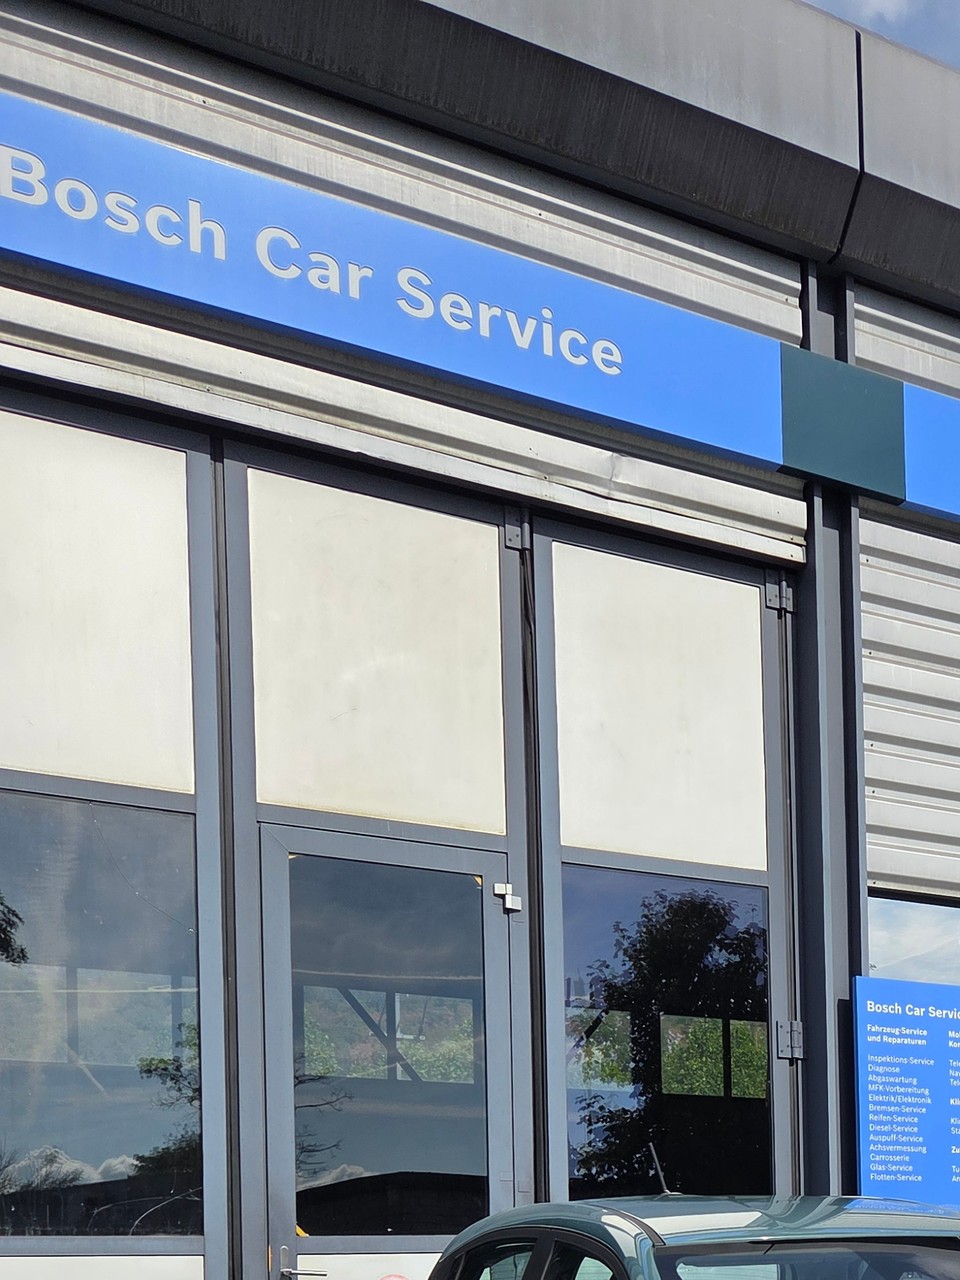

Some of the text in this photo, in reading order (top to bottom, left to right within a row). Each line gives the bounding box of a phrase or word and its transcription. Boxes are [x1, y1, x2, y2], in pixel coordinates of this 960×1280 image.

[0, 144, 624, 376] Bosch Car Service
[867, 1001, 902, 1015] Bosch
[905, 1004, 926, 1017] Car
[867, 1024, 928, 1036] Fahrzeug-Service
[882, 1035, 927, 1046] Reparaturen
[867, 1054, 935, 1066] Inspektions-Service
[867, 1063, 900, 1074] Diagnose
[867, 1073, 918, 1086] Abgaswartung
[868, 1083, 930, 1096] MFK-Vorbereitung
[868, 1093, 932, 1104] Elektrik/Elektronik
[868, 1103, 927, 1114] Bremsen-Service
[869, 1113, 919, 1123] Reifen-Service
[869, 1123, 919, 1133] Diesel-Service
[869, 1133, 924, 1143] Auspuff-Service
[869, 1143, 928, 1154] Achsvermessung
[869, 1153, 910, 1162] Carrosserie
[869, 1163, 914, 1172] Glas-Service
[870, 1172, 923, 1182] Flotten-Service
